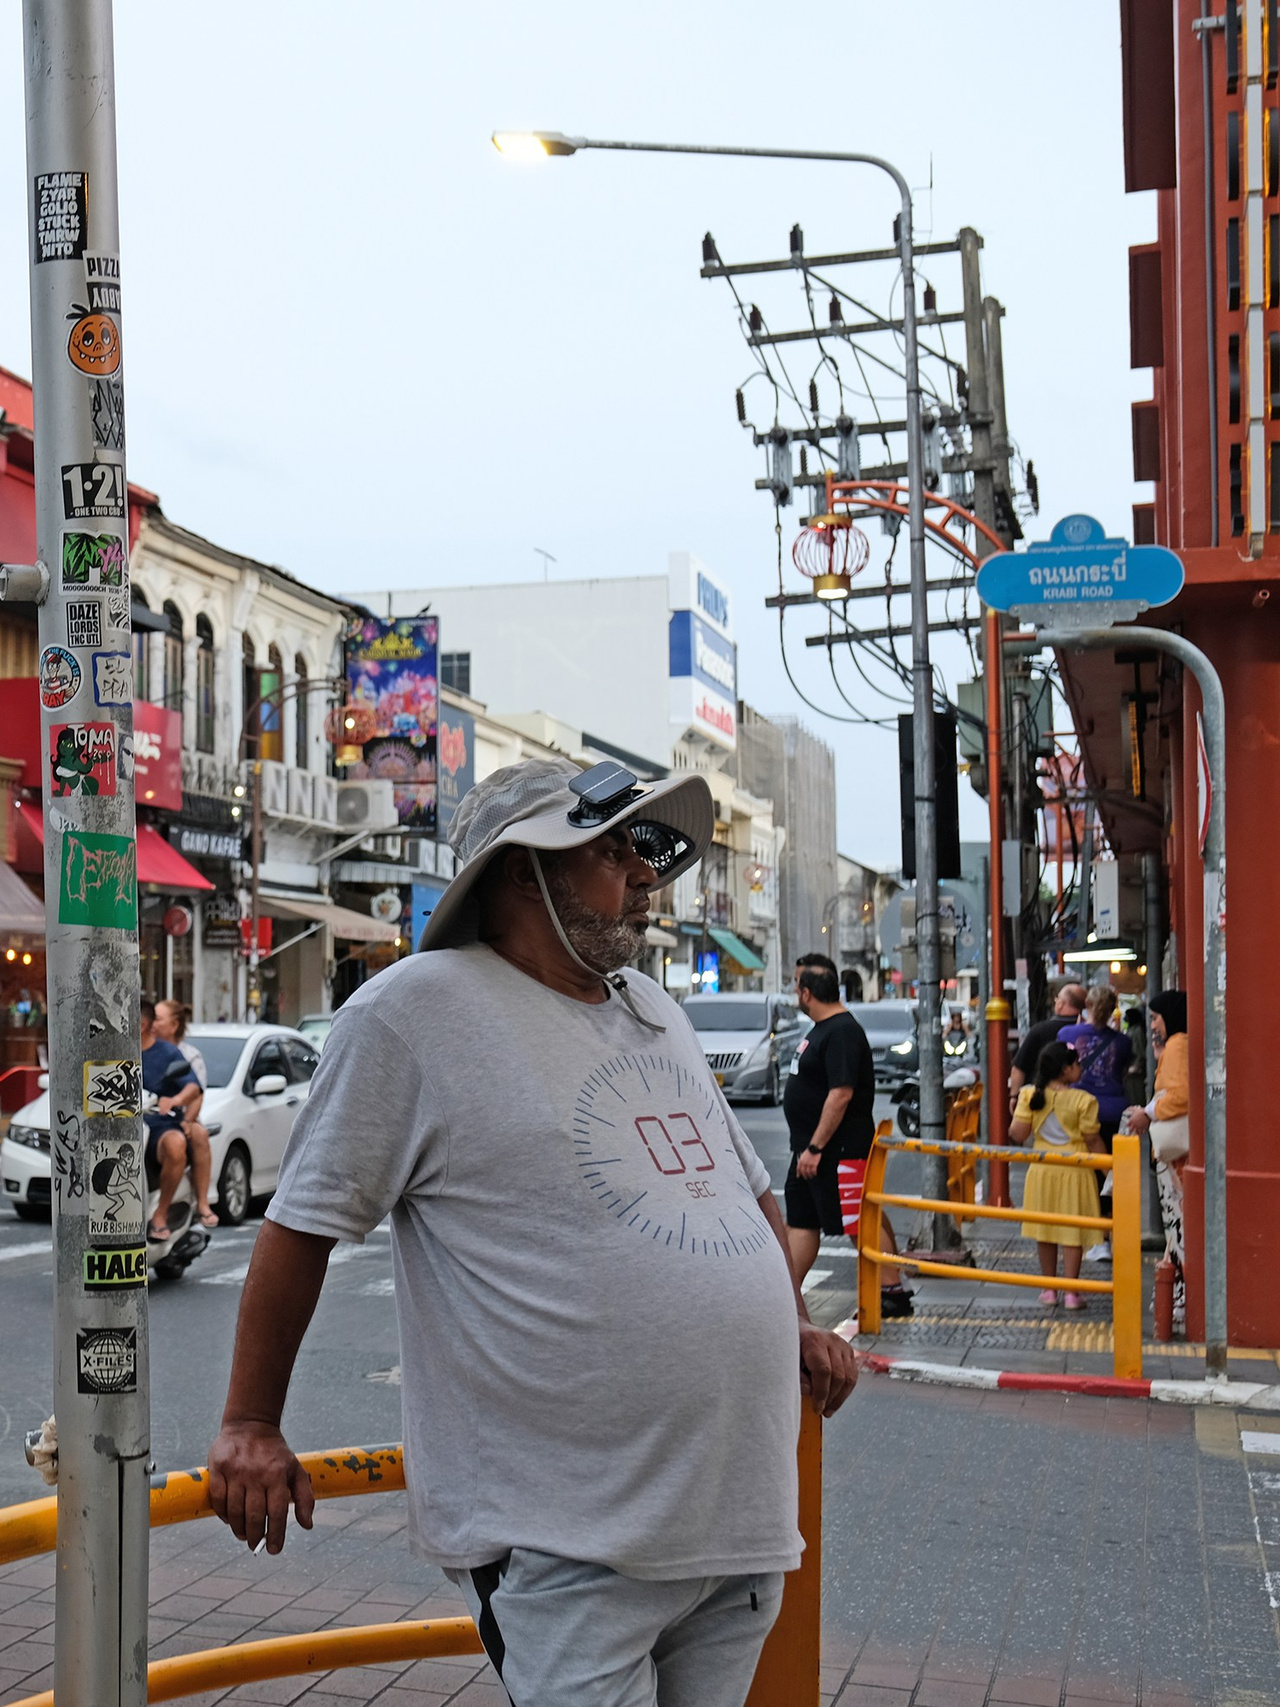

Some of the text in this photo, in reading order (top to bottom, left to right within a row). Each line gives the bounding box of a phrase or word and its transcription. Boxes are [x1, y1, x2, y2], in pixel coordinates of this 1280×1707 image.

[37, 173, 82, 190] FLAME
[38, 214, 80, 231] STUCK
[38, 228, 80, 246] TMRW
[41, 242, 74, 258] NITO
[74, 506, 90, 517] ONE
[91, 506, 108, 516] TWO
[1028, 551, 1127, 586] ถนนกระบี่
[1043, 585, 1113, 600] KRABI ROAD
[69, 603, 98, 620] DAZE
[70, 620, 99, 634] LORDS
[86, 633, 100, 644] UTL
[59, 649, 77, 667] FUCK
[73, 666, 80, 677] IS
[43, 689, 66, 708] RAY
[67, 724, 115, 754] TOMA
[634, 1112, 716, 1175] 03
[685, 1180, 717, 1199] SEC
